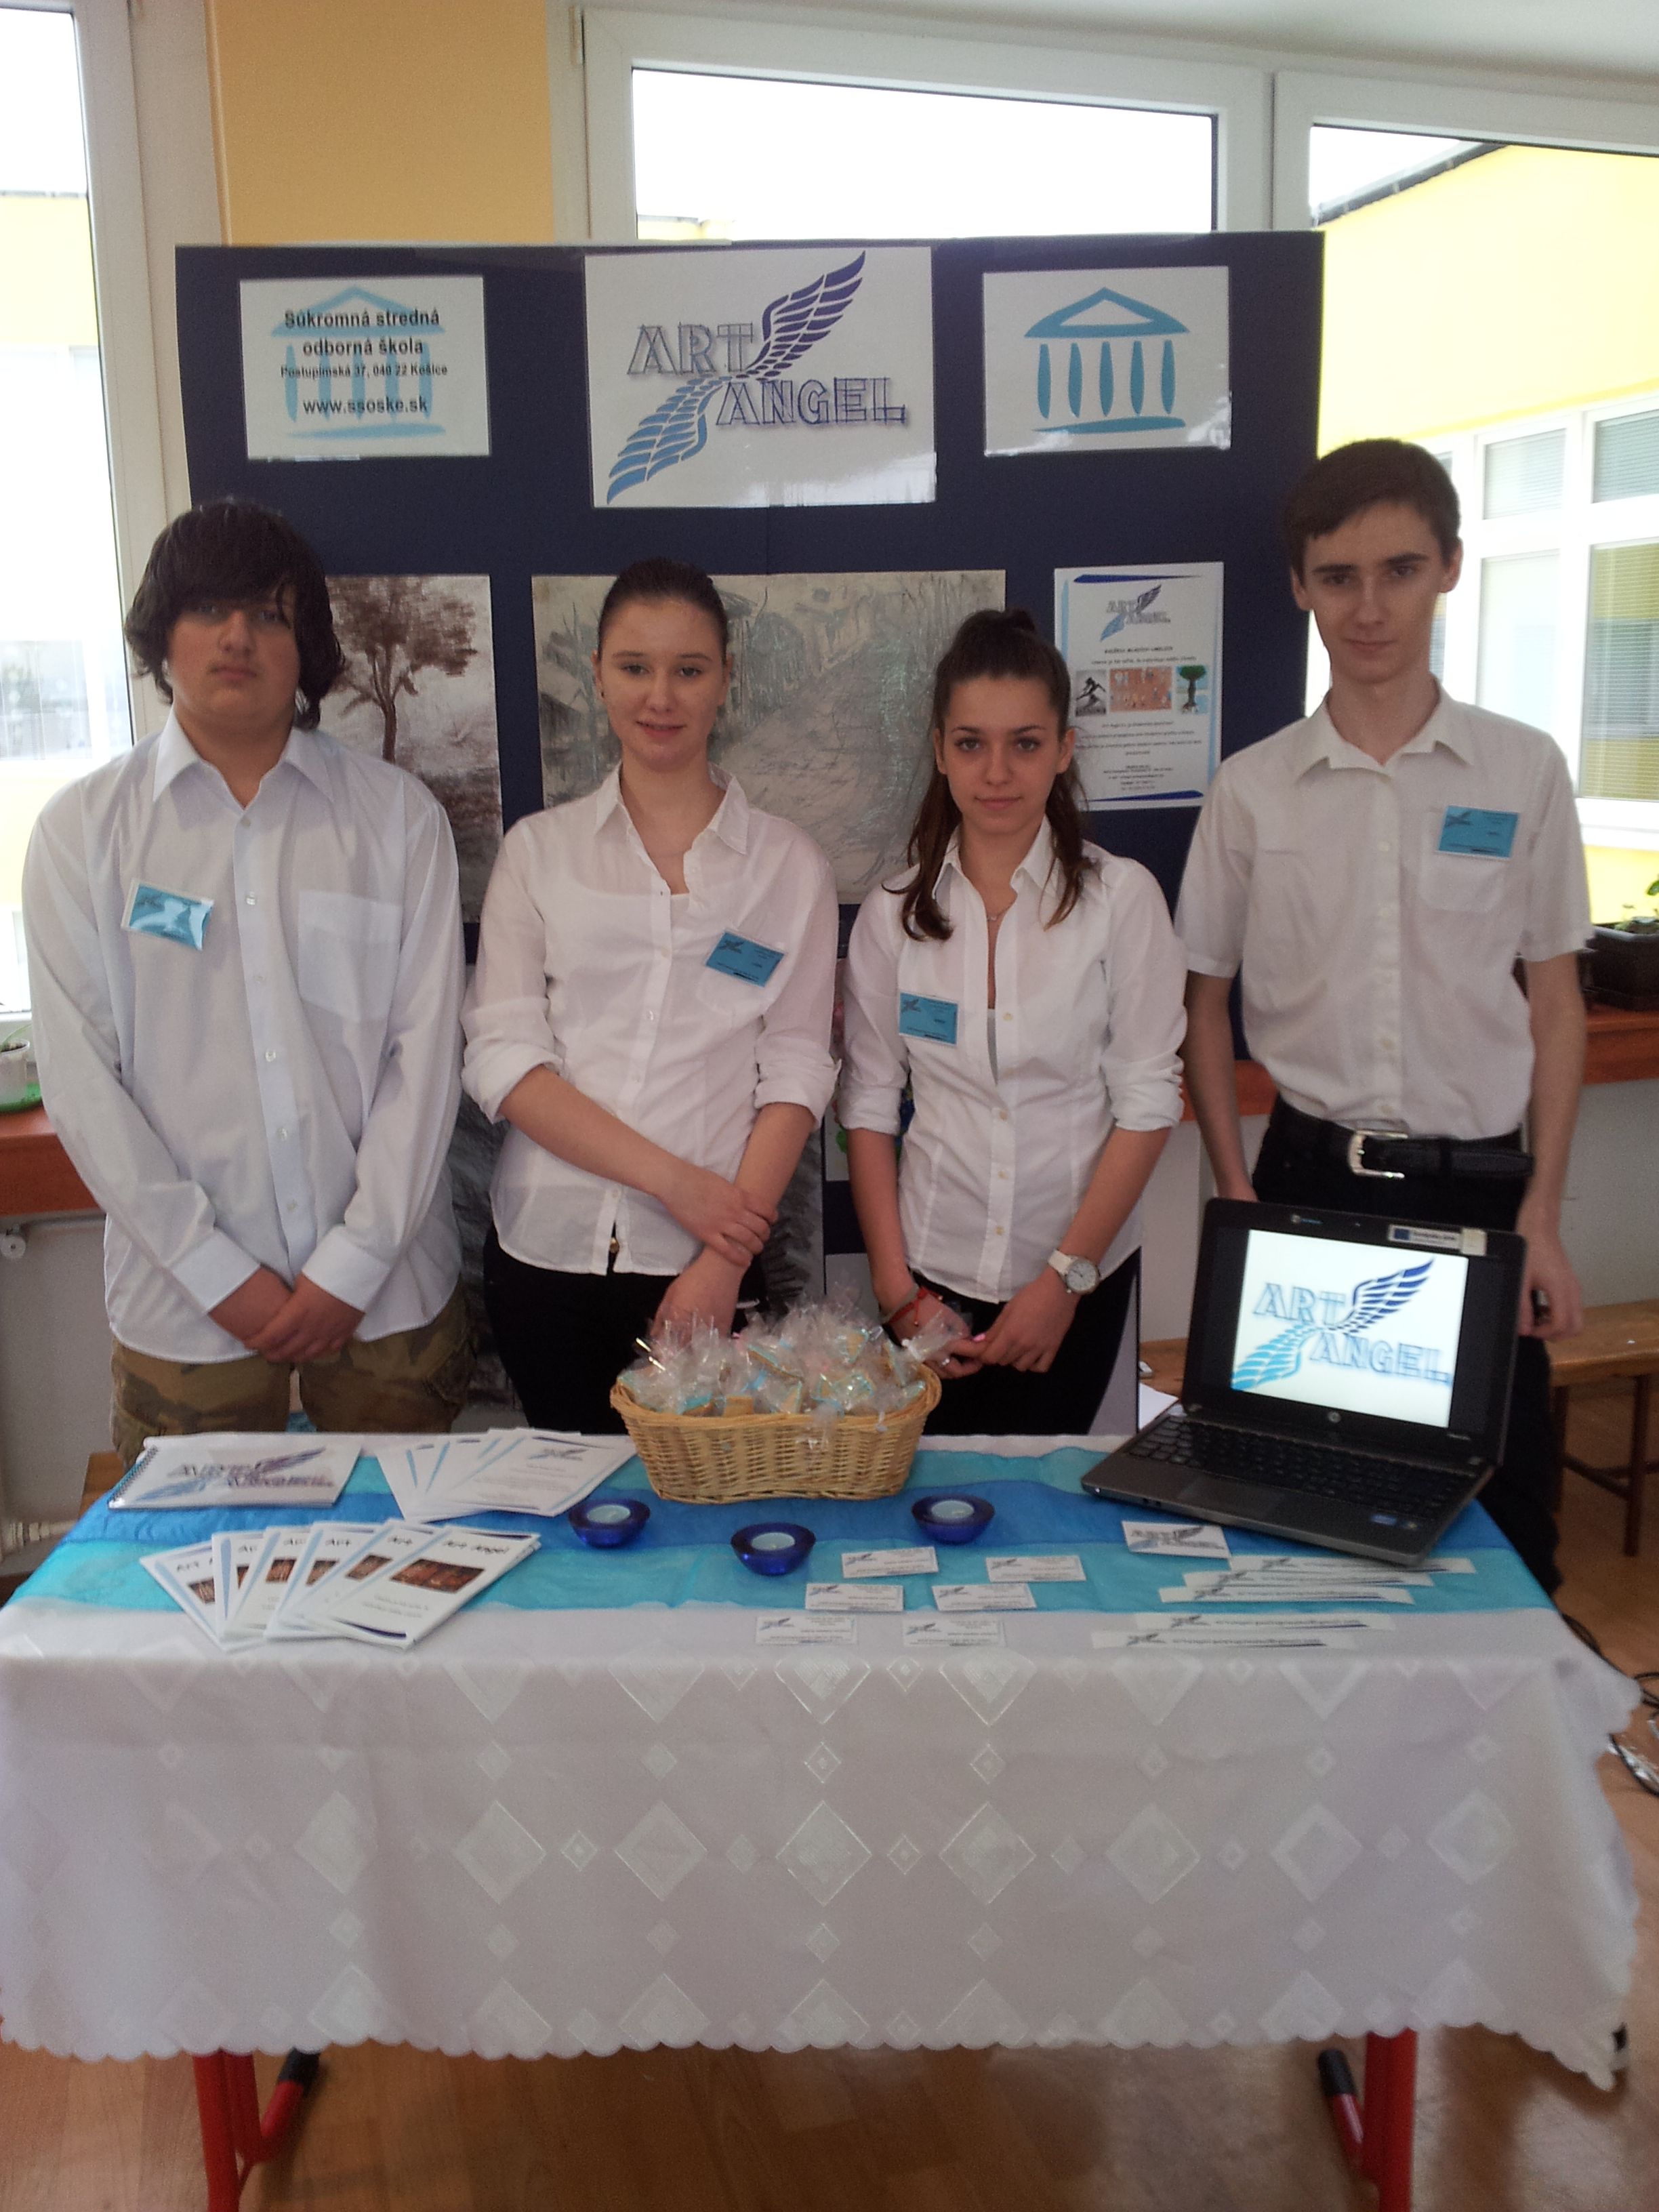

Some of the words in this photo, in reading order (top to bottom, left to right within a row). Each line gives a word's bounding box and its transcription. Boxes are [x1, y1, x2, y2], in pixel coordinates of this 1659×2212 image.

[285, 308, 370, 329] Súkromná
[377, 307, 440, 327] stredná
[303, 337, 373, 356] odborná
[379, 335, 424, 356] škola
[627, 321, 754, 375] ART
[303, 395, 428, 415] www.ssoske.sk
[716, 377, 907, 427] ANGEL
[1252, 1282, 1349, 1326] ART
[1310, 1332, 1452, 1385] ANGEL
